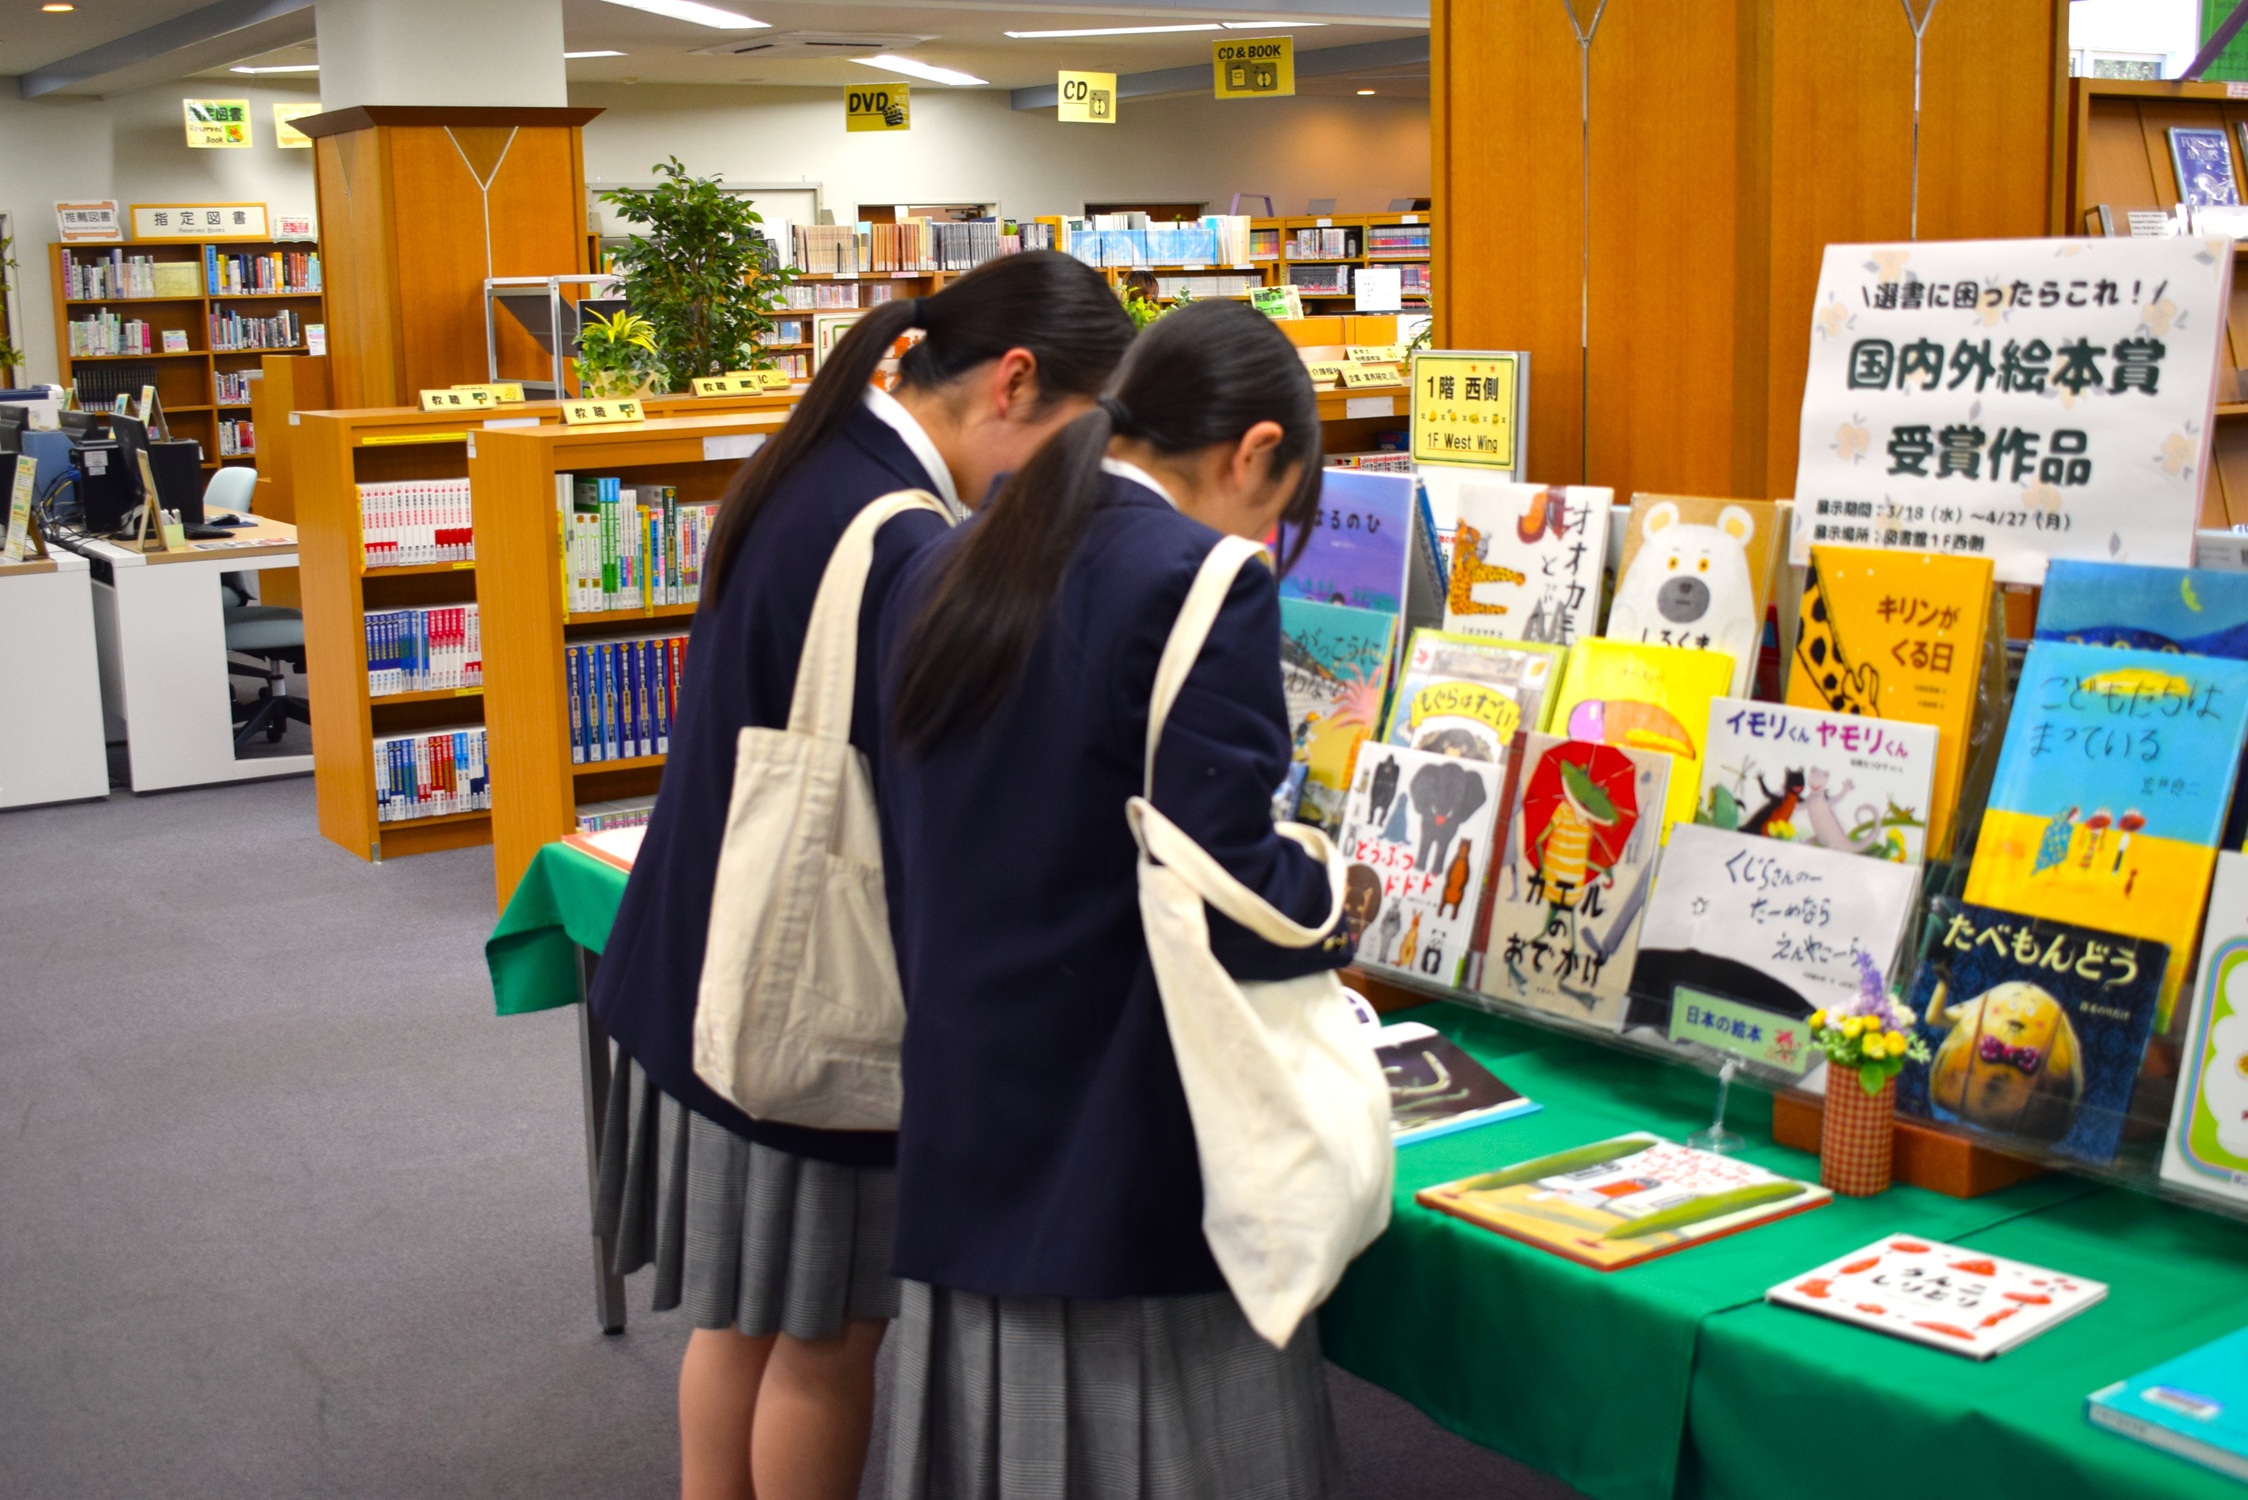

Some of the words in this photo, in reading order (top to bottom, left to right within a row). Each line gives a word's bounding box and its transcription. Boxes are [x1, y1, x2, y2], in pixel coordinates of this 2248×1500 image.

[848, 92, 889, 113] DVD
[1063, 79, 1088, 102] CD
[206, 135, 224, 143] Book
[65, 211, 111, 223] 推薦図書
[154, 211, 246, 226] 指定図書
[1845, 336, 2167, 397] 国内外絵本賞
[431, 394, 462, 406] 教職
[1427, 375, 1455, 401] 1階
[1465, 375, 1499, 402] 西側
[574, 406, 606, 419] 教職
[1427, 432, 1439, 448] 1F
[1444, 432, 1472, 450] West
[1477, 433, 1498, 453] Wing
[1886, 424, 2093, 487] 受賞作品
[1878, 596, 1958, 629] キリンが
[1294, 628, 1382, 666] がっこうに
[1891, 637, 1955, 674] くる日
[1421, 687, 1512, 727] もぐらはすごい
[2039, 675, 2224, 722] こどもたちは
[1726, 709, 1810, 744] イモリくん
[1815, 720, 1908, 759] ヤモリくん
[2030, 721, 2160, 762] まっている
[1355, 838, 1417, 872] どうぶつ
[1384, 872, 1439, 897] ドドド
[1527, 874, 1606, 918] カエル
[1548, 919, 1567, 937] の
[1503, 932, 1605, 988] おでかけ
[1942, 913, 2139, 988] たべもんどう
[1685, 1004, 1763, 1044] 日本の絵本
